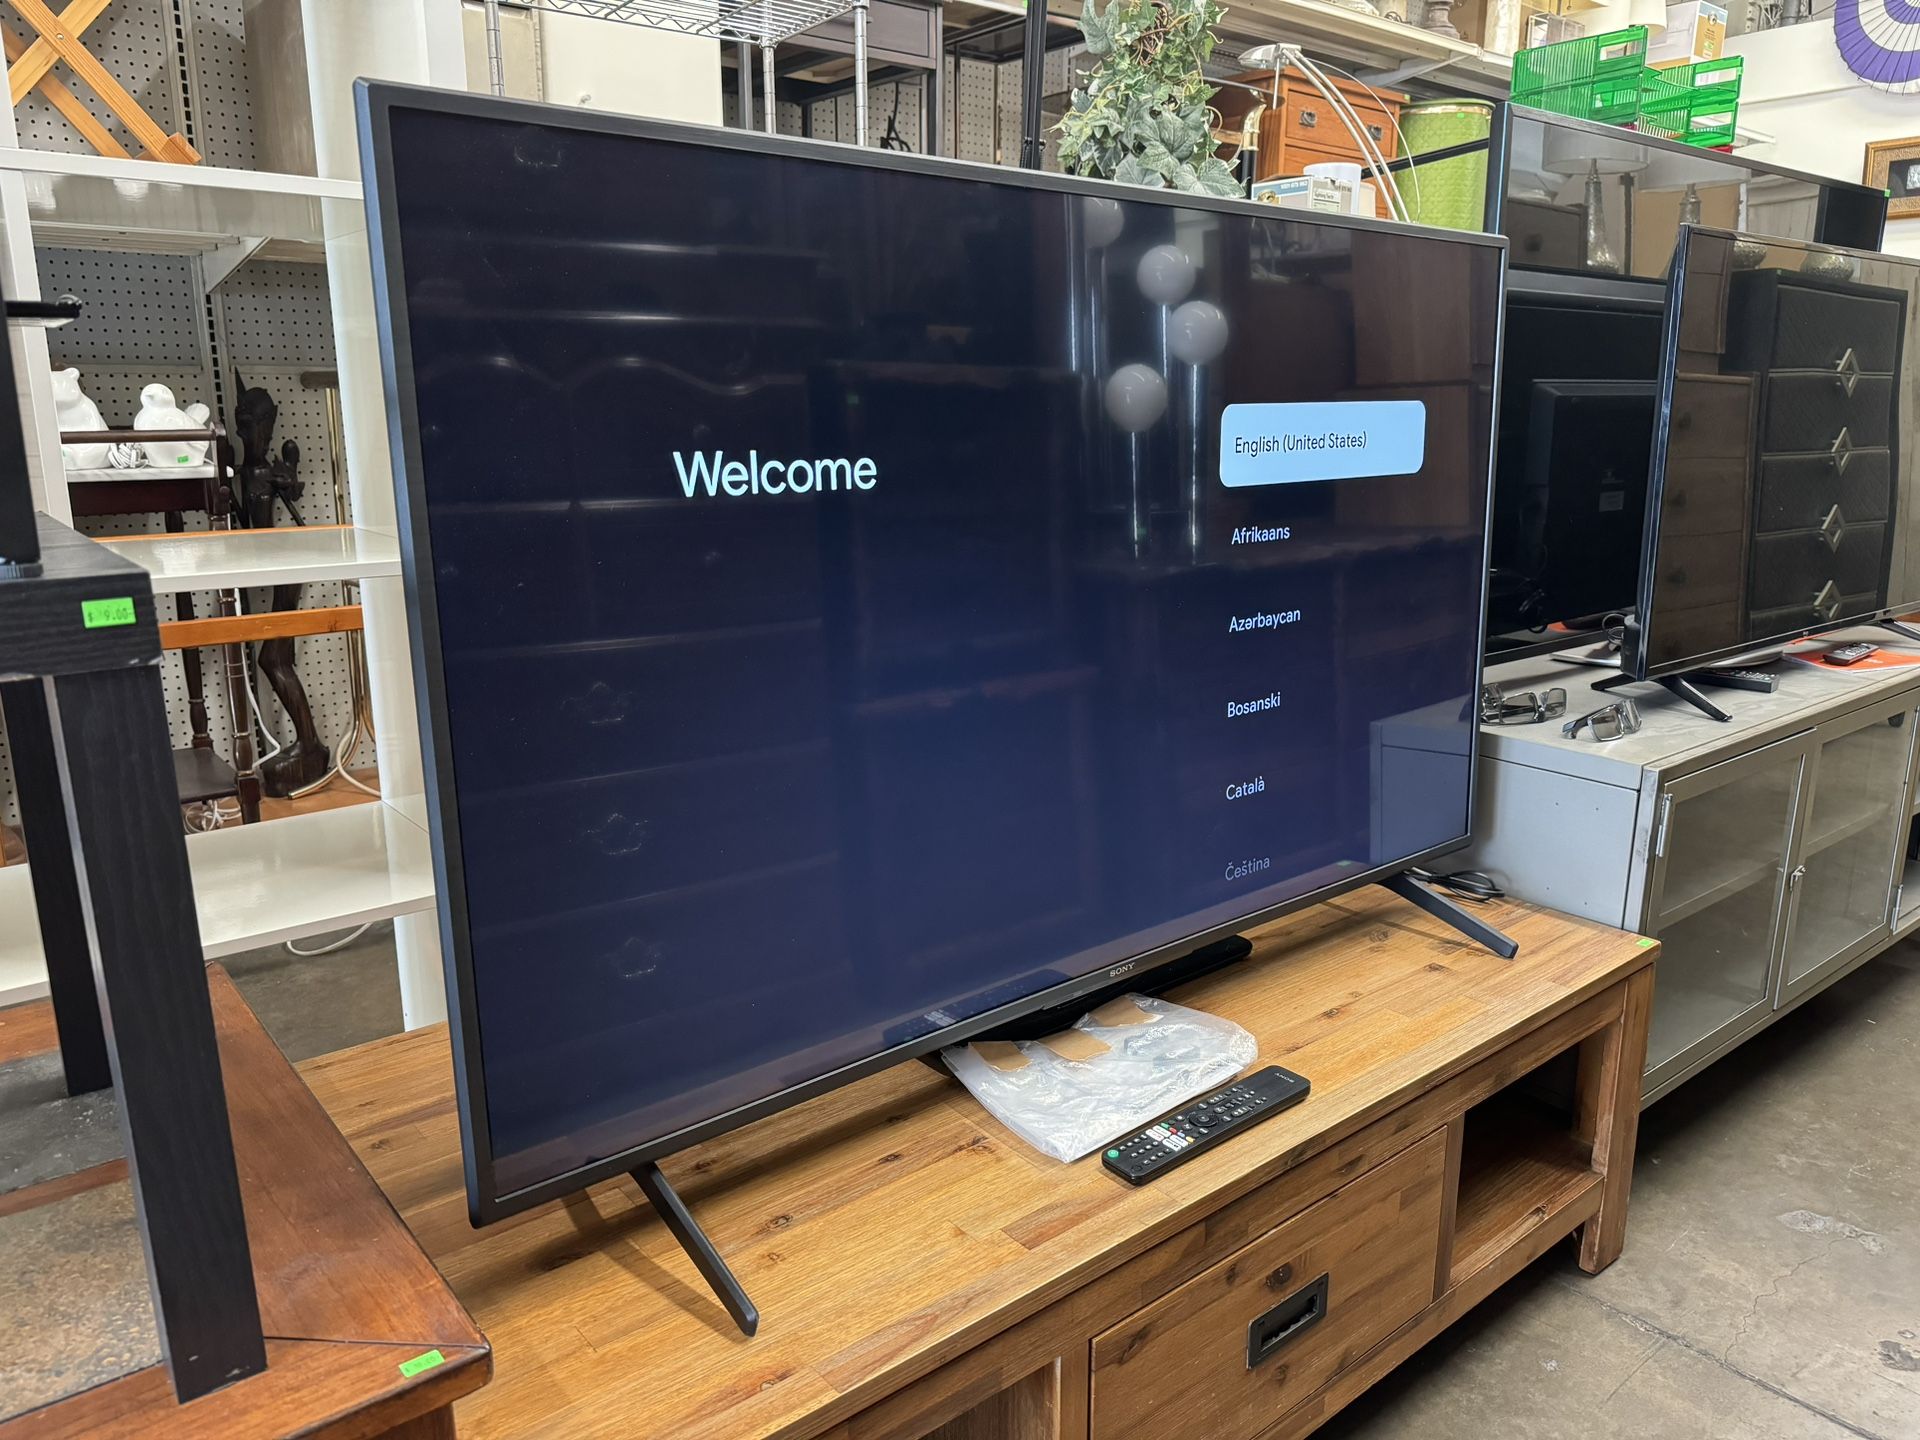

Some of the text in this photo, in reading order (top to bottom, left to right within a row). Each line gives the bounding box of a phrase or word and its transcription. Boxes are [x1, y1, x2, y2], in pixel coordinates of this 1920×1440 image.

[1235, 431, 1367, 457] English (United States)
[672, 449, 877, 498] Welcome
[1231, 525, 1290, 545] Afrikaans
[1228, 608, 1301, 633] Azərbaycan
[1227, 691, 1281, 717] Bosanski
[1225, 775, 1265, 800] Català
[1224, 857, 1270, 881] Čeština
[1109, 961, 1136, 978] SONY
